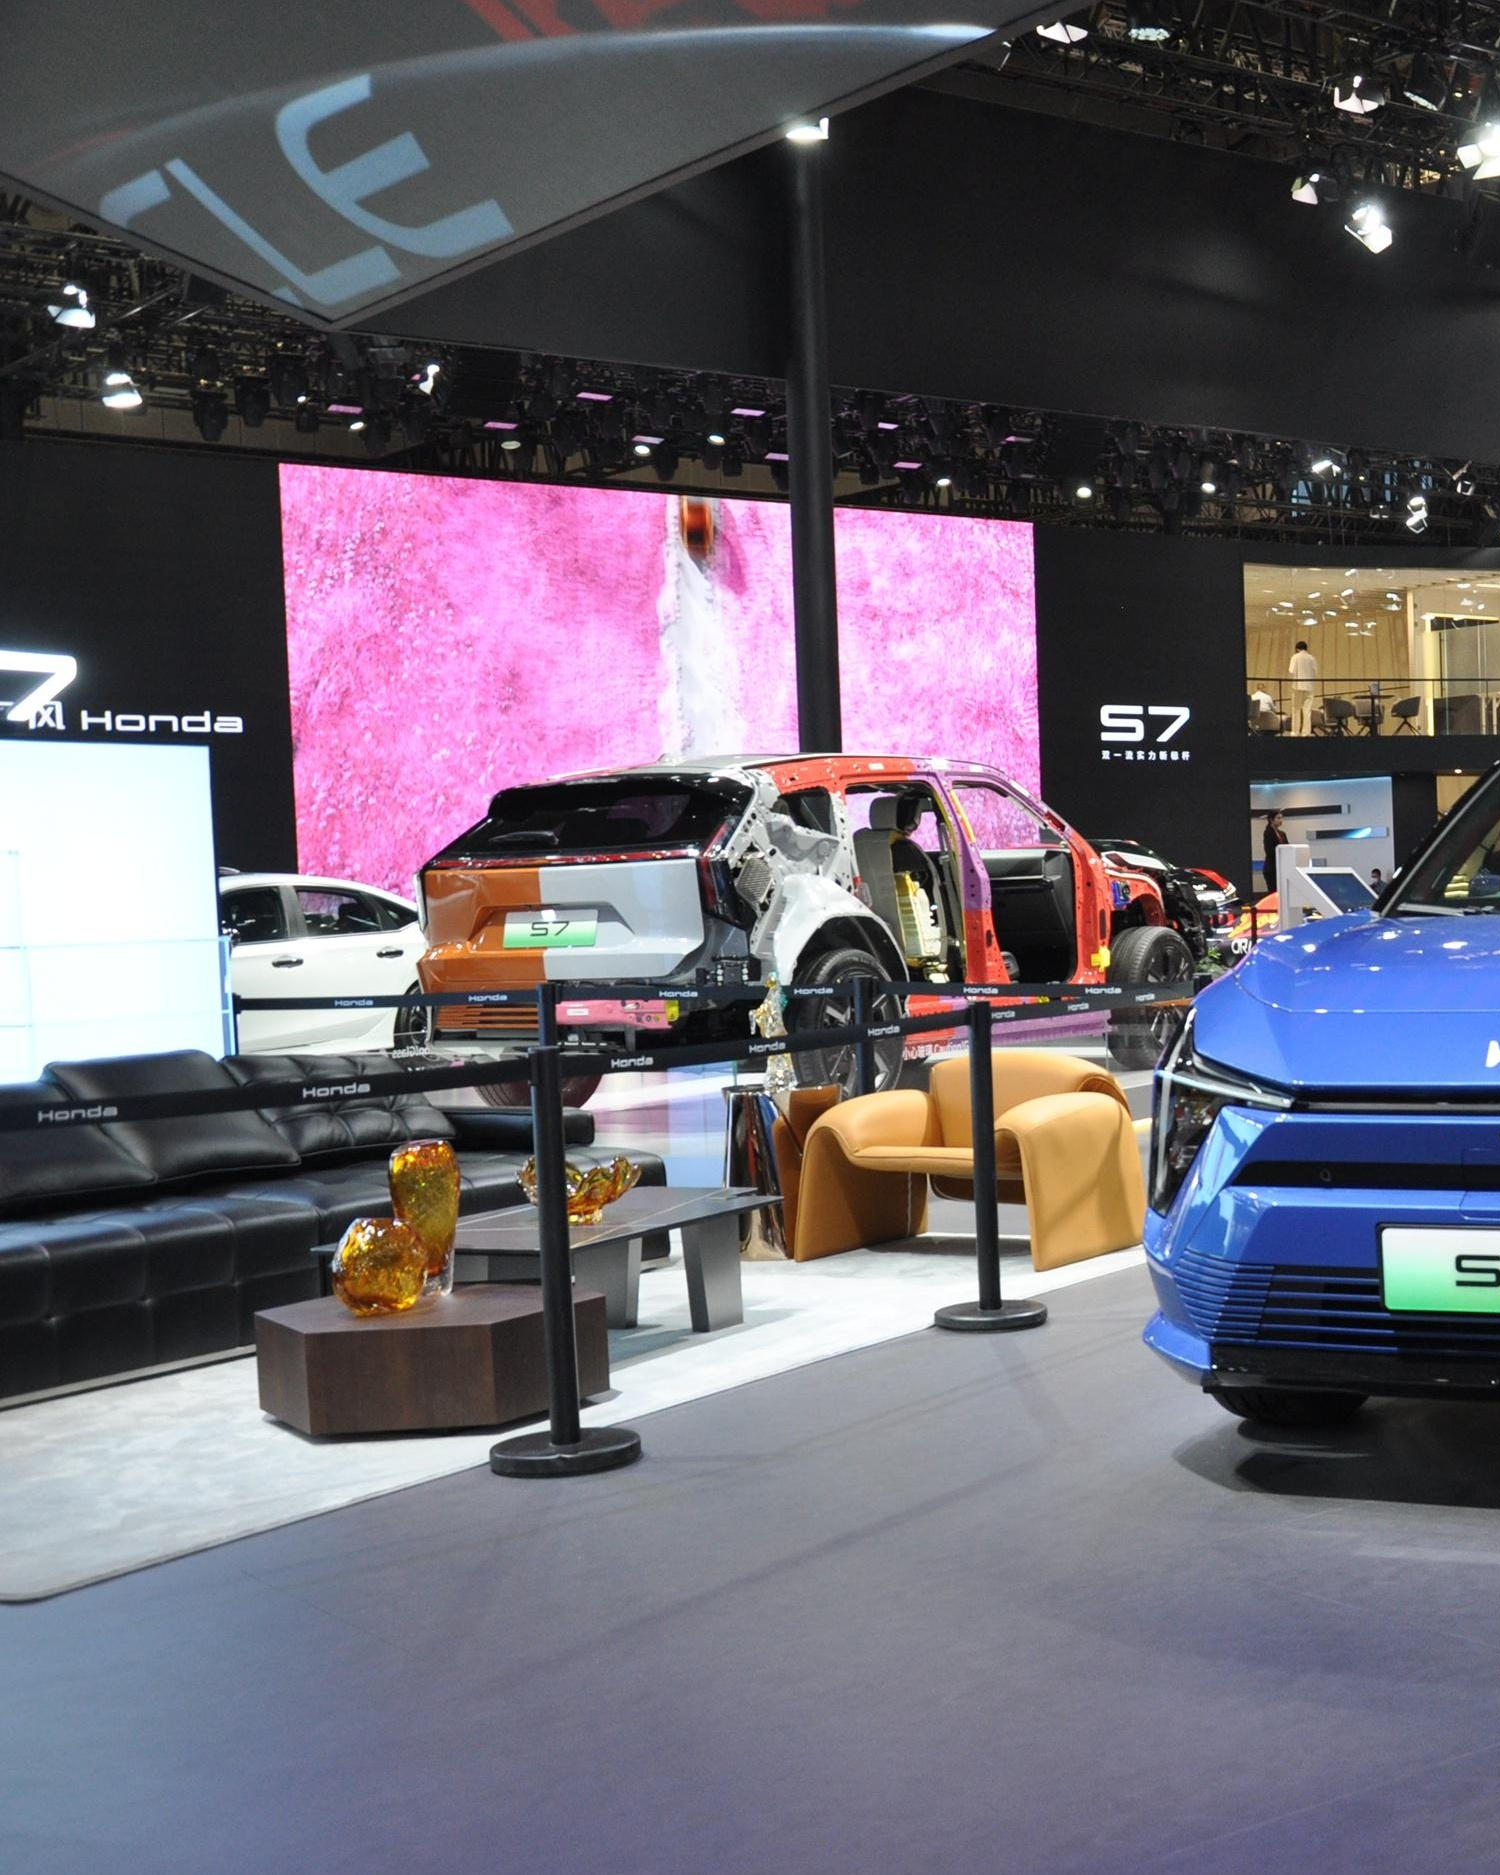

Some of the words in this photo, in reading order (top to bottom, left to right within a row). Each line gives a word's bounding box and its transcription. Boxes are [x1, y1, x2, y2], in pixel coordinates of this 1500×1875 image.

[80, 709, 244, 733] Honda
[1100, 704, 1190, 743] S7
[530, 921, 570, 936] S7
[658, 990, 699, 998] Honda
[793, 987, 834, 996] Honda
[963, 986, 1000, 995] Honda
[1085, 985, 1123, 995] Honda
[334, 999, 374, 1007] Honda
[468, 994, 509, 1003] Honda
[867, 1024, 901, 1037] Honda
[748, 1040, 787, 1054] Honda
[610, 1055, 654, 1069] Honda
[302, 1080, 372, 1099] Honda
[37, 1105, 118, 1124] Honda
